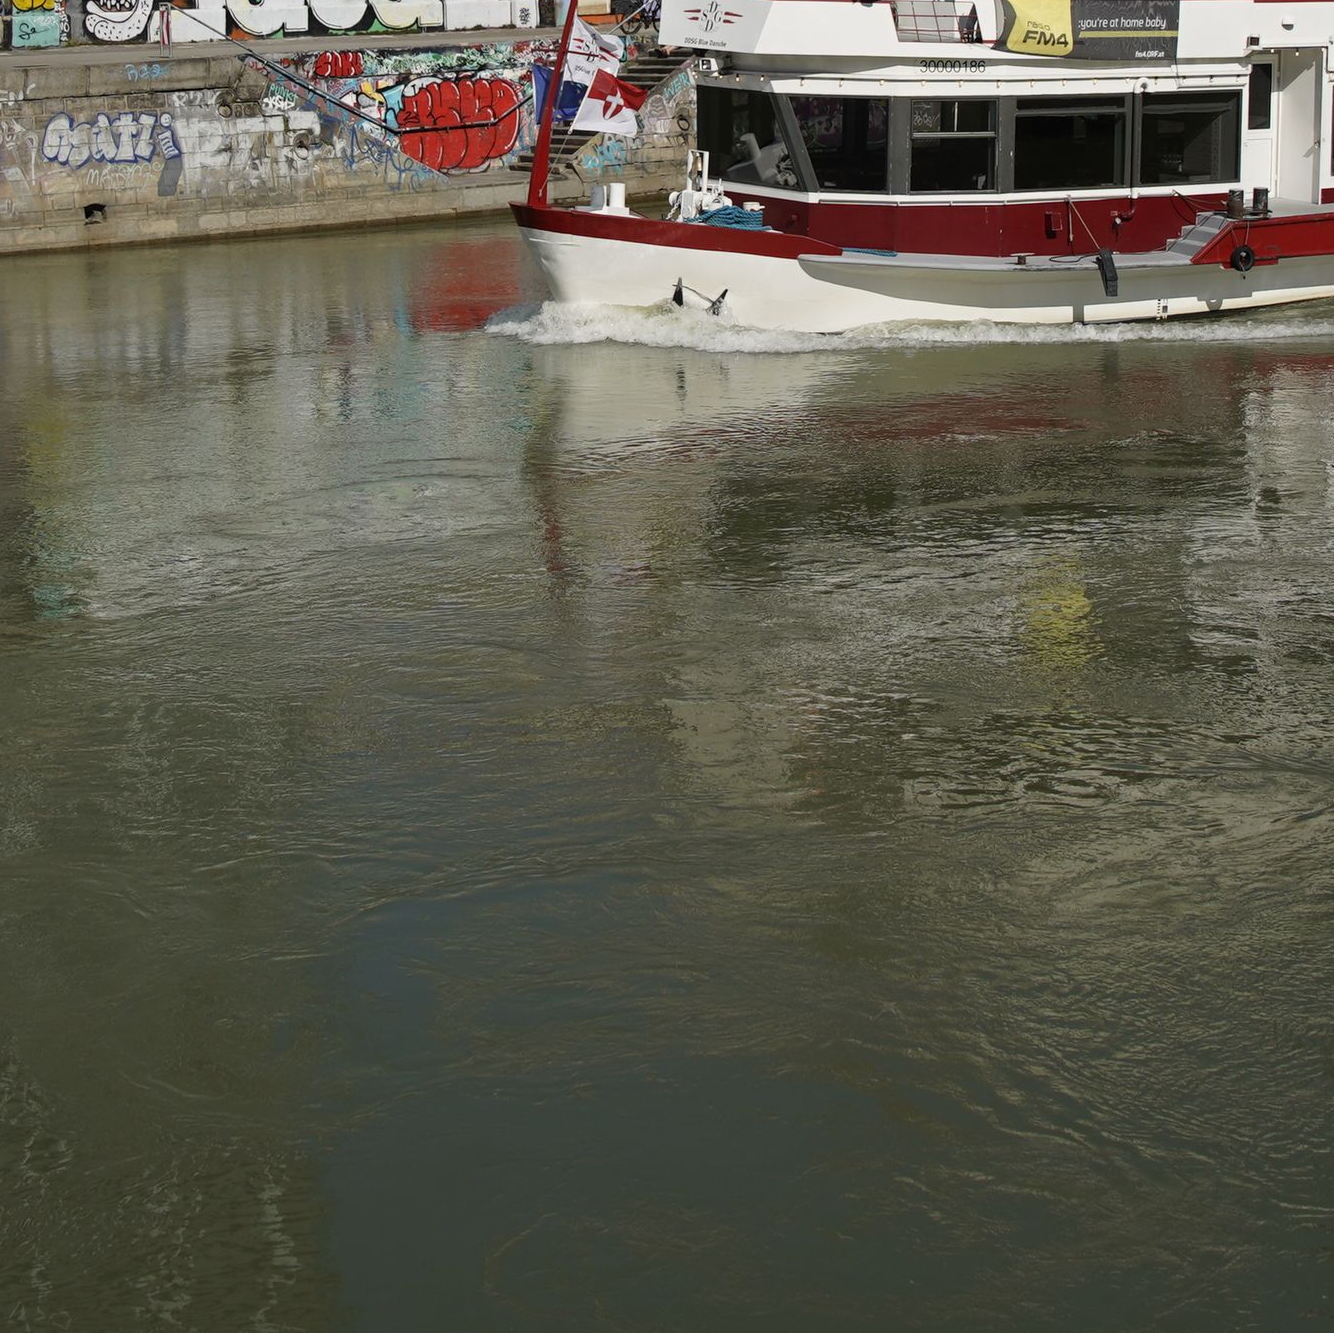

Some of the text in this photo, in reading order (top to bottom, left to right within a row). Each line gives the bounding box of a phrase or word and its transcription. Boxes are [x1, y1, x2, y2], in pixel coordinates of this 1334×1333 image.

[1110, 18, 1118, 27] at
[1121, 18, 1143, 27] home
[1145, 16, 1167, 29] baby
[1022, 30, 1069, 48] FM4
[920, 60, 986, 73] 30000186
